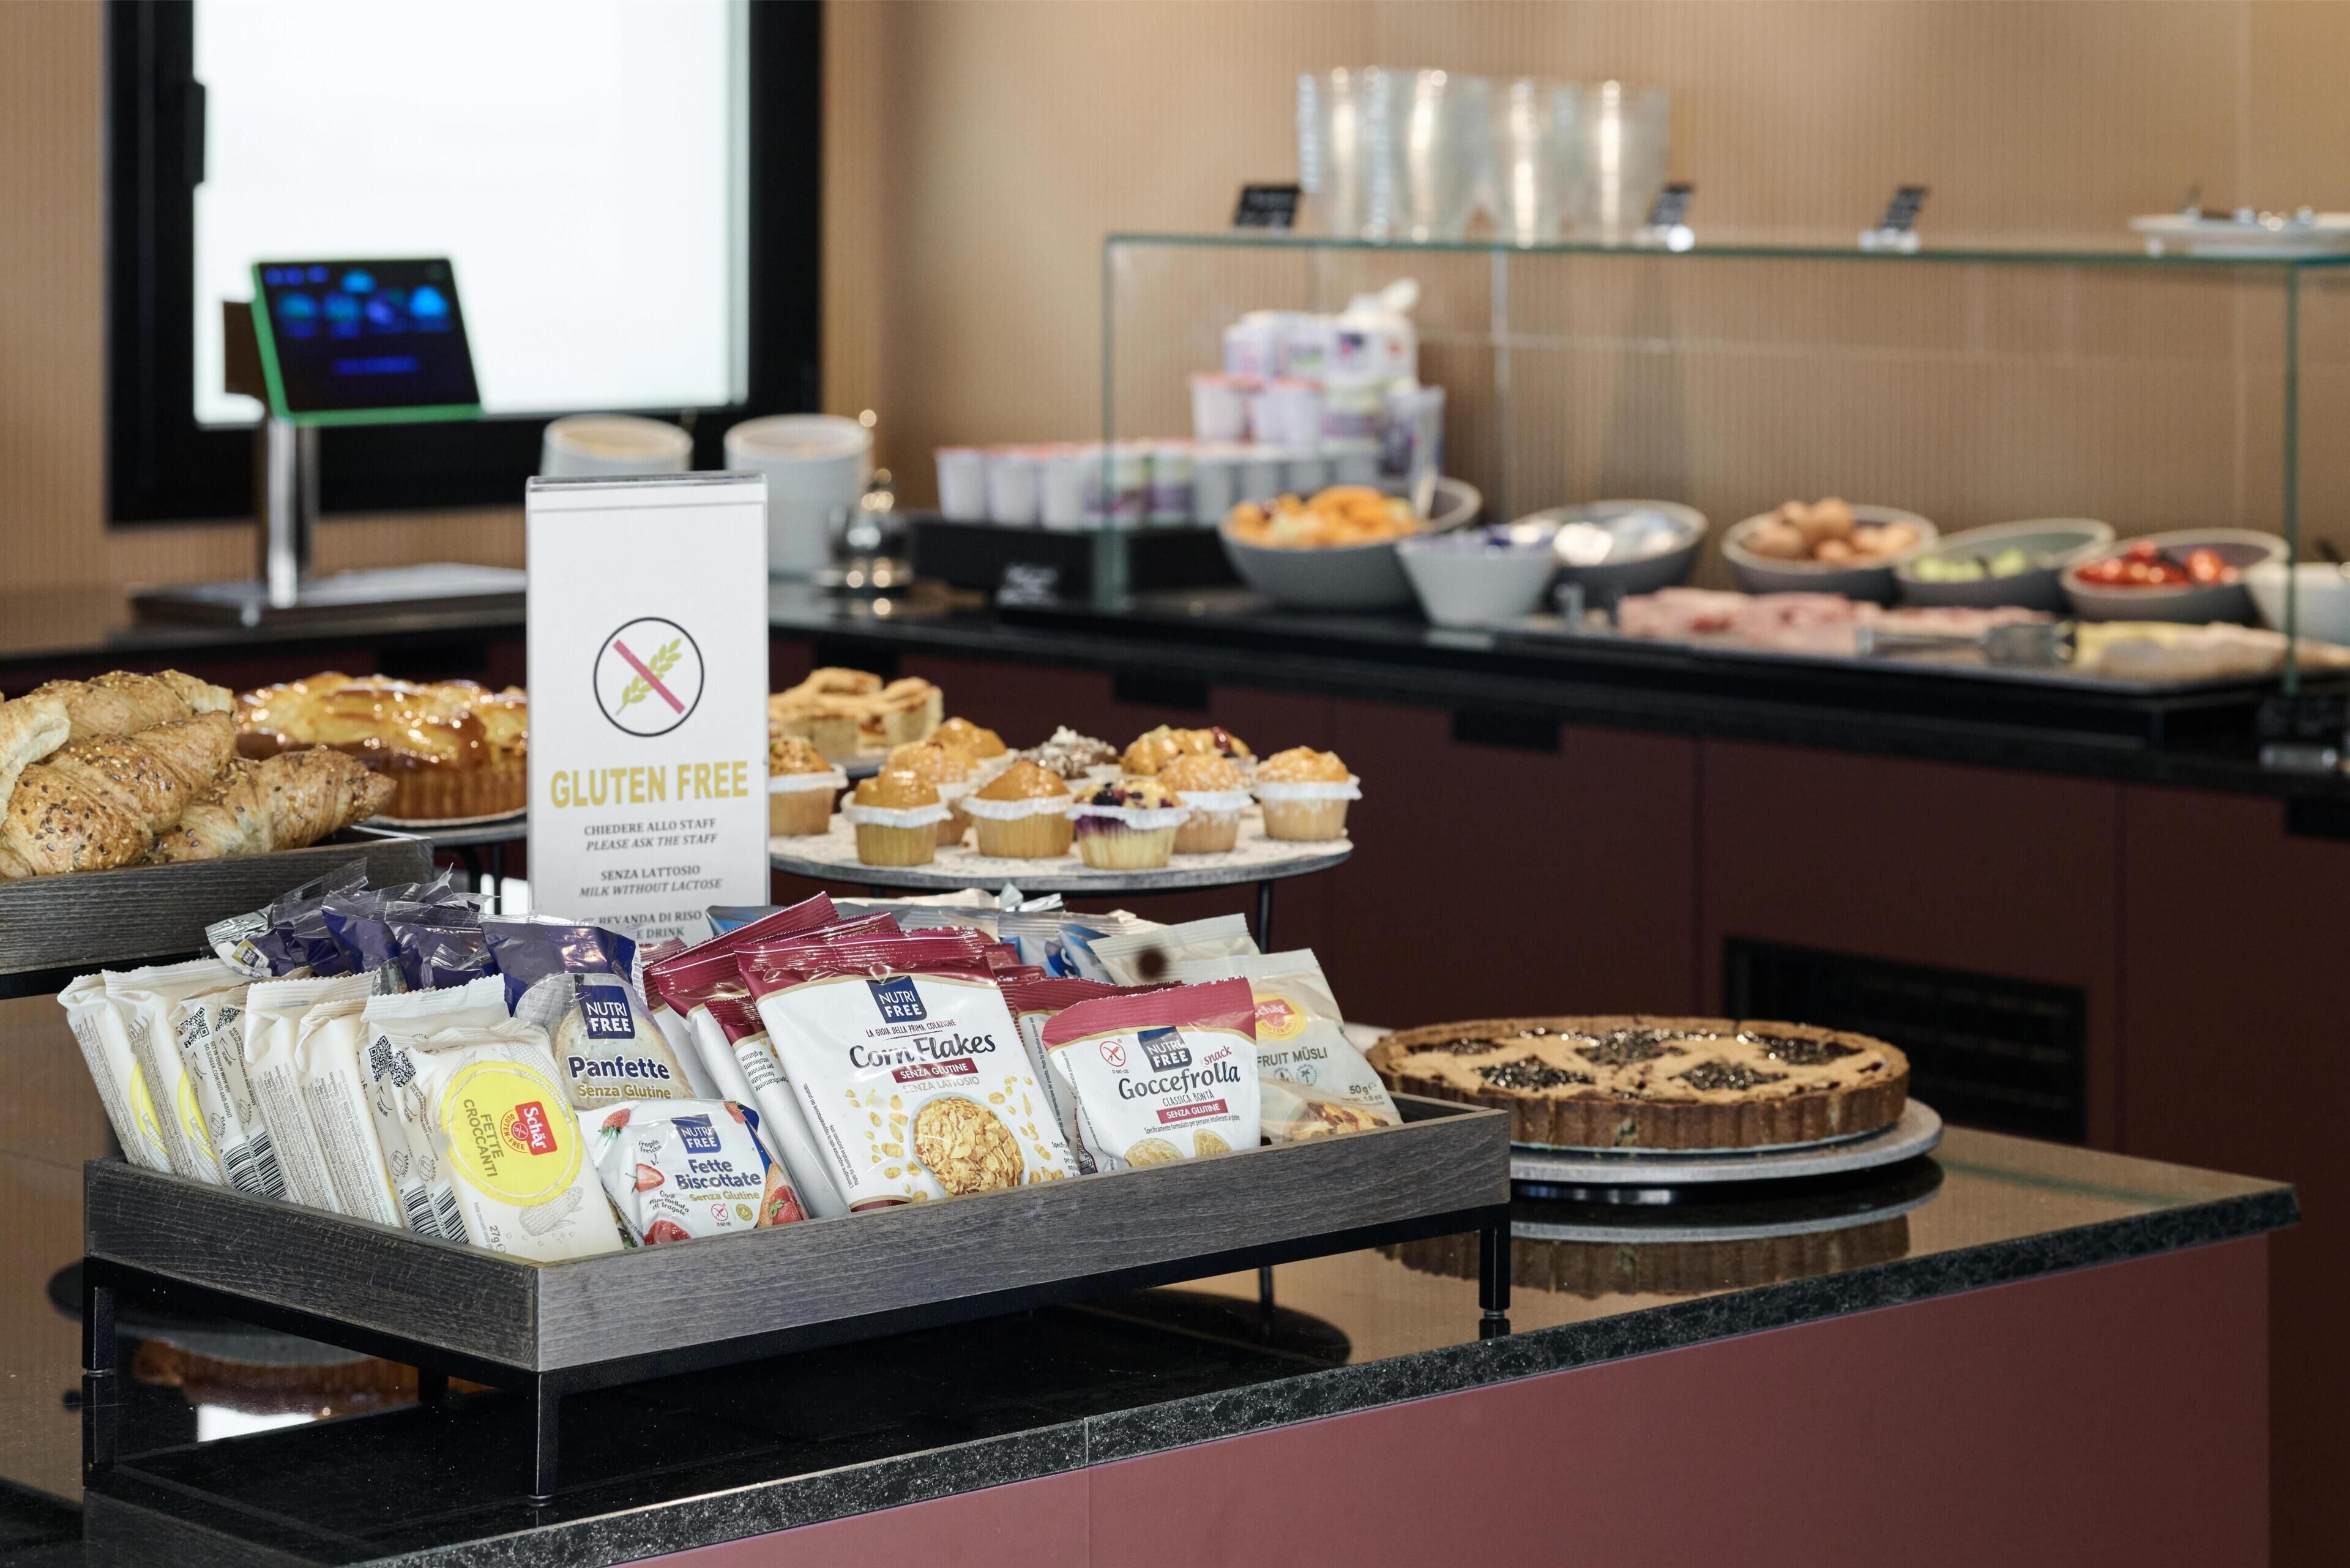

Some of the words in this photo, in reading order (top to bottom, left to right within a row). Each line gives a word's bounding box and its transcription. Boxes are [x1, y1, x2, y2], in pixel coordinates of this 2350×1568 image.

[550, 765, 666, 808] GLUTEN
[677, 761, 749, 801] FREE
[584, 822, 644, 836] CHIEDERE
[647, 821, 677, 832] ALLO
[680, 818, 716, 829] STAFF
[586, 840, 629, 851] PLEASE
[631, 837, 654, 848] ASK
[657, 835, 680, 847] THE
[682, 833, 718, 845] STAFF
[600, 869, 638, 881] SENZA
[641, 865, 701, 879] LATTOSIO
[579, 886, 609, 898] MILK
[611, 882, 668, 896] WITHOUT
[671, 878, 723, 892] LACTOSE
[658, 911, 671, 923] DI
[674, 910, 702, 921] RISO
[646, 926, 685, 939] DRINK
[878, 990, 916, 1004] NUTRI
[586, 1001, 627, 1016] NUTRI
[884, 1004, 922, 1017] FREE
[590, 1017, 632, 1032] FREE
[875, 1027, 891, 1036] GIOIA
[892, 1026, 907, 1035] DELLA
[908, 1024, 926, 1033] PRIMA
[927, 1019, 957, 1030] COLAZIONE
[849, 1045, 914, 1069] Corn
[913, 1032, 996, 1062] Flakes
[1204, 1045, 1232, 1066] snack
[1292, 1047, 1328, 1062] MÜSLI
[1152, 1051, 1188, 1067] FREE
[567, 1056, 671, 1080] Panfette
[747, 1065, 766, 1077] persone
[900, 1069, 931, 1079] SENZA
[931, 1063, 969, 1075] GLUTINE
[751, 1071, 775, 1084] formulato
[903, 1082, 936, 1093] SENZA
[938, 1077, 980, 1088] LATTOSIO
[1119, 1061, 1241, 1100] Goccefrolla
[577, 1084, 620, 1097] Senza
[623, 1084, 671, 1099] Glutine
[1162, 1094, 1192, 1107] CLASSICA
[1193, 1089, 1215, 1102] BONTÀ
[1166, 1108, 1191, 1119] SENZA
[1191, 1103, 1220, 1116] GLUTINE
[503, 1113, 525, 1150] GLUTEN-FREE
[523, 1107, 546, 1149] Schär
[681, 1126, 712, 1137] NUTRI
[1144, 1125, 1171, 1135] Specificamente
[1195, 1119, 1210, 1127] persone
[463, 1099, 498, 1177] CROCCANTI
[480, 1114, 504, 1159] FETTE
[685, 1137, 717, 1148] FREE
[688, 1159, 733, 1174] Fette
[674, 1172, 762, 1190] Biscottate
[689, 1193, 721, 1201] Senza
[723, 1190, 760, 1200] Glutine
[662, 1201, 686, 1216] fragole
